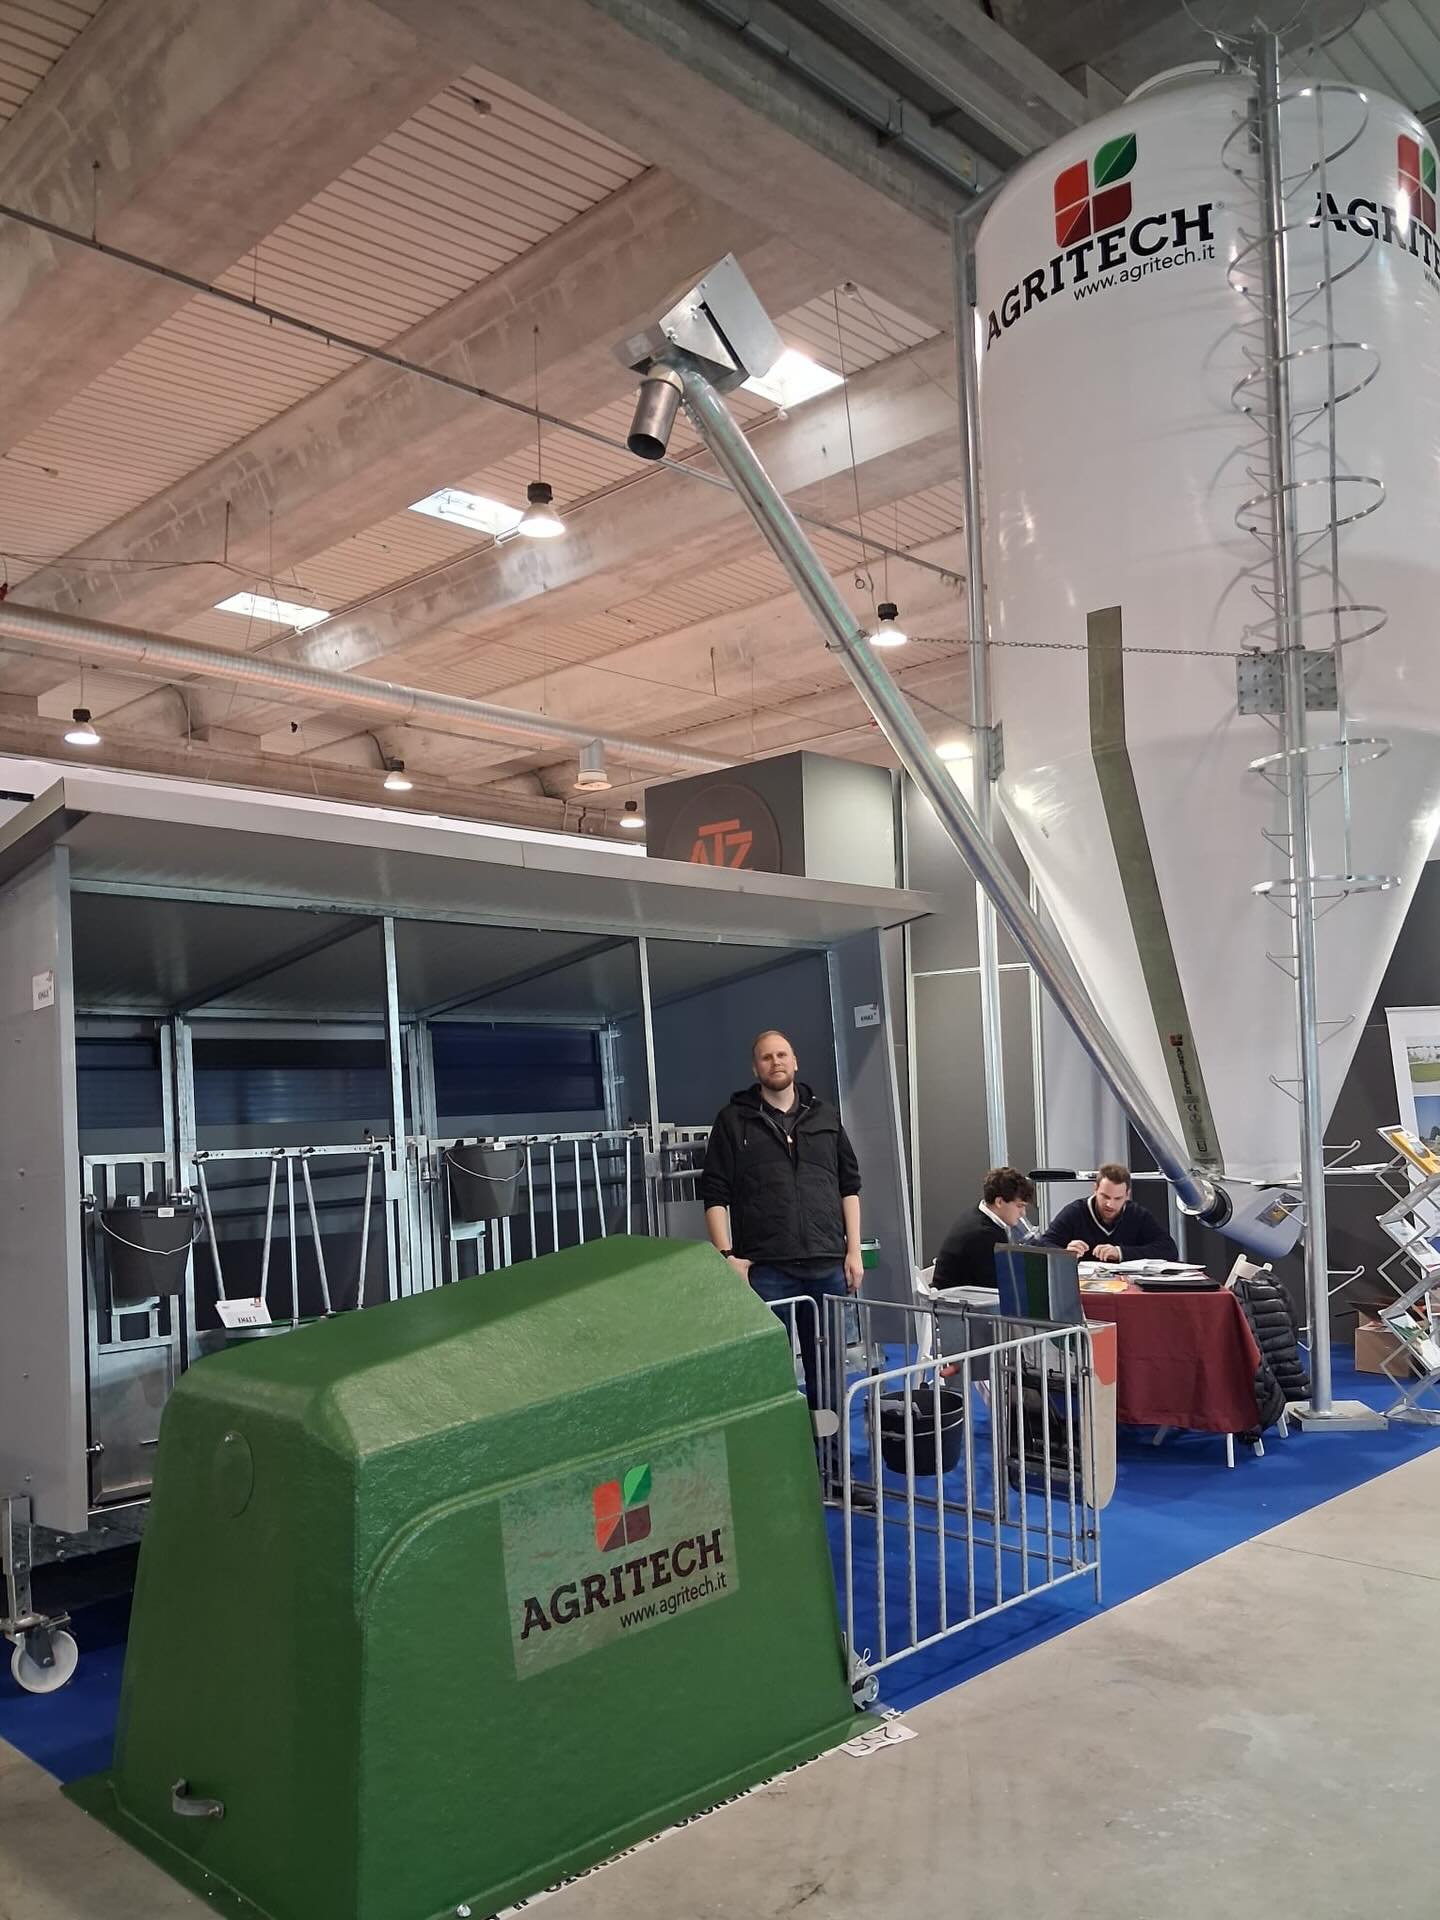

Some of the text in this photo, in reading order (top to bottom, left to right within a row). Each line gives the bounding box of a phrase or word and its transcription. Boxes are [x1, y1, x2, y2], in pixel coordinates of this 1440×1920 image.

[986, 203, 1214, 350] AGRITECH
[1073, 244, 1216, 301] www.agritech.it
[519, 1528, 724, 1640] AGRITECH
[619, 1571, 728, 1629] www.agritech.it
